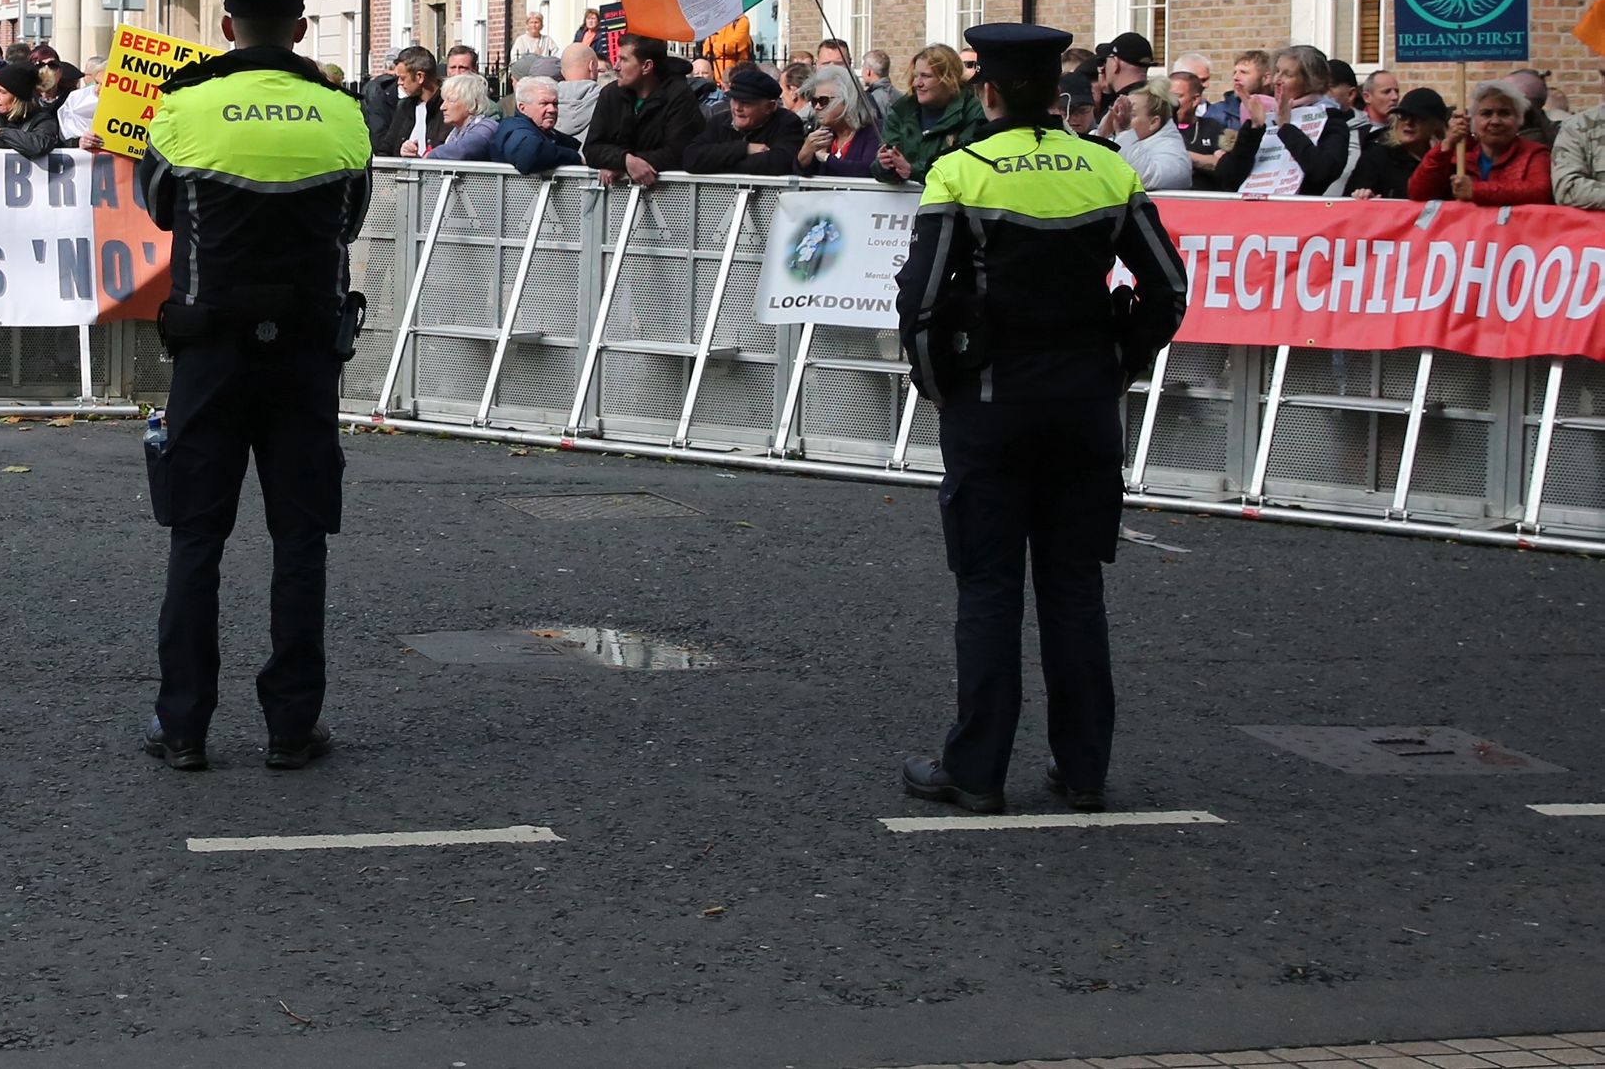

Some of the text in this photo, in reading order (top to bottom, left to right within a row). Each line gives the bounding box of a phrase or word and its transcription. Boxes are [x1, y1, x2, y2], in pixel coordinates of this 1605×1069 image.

[119, 31, 171, 57] BEEP
[173, 46, 193, 62] IF
[1398, 31, 1526, 47] IRELAND FIRST
[105, 72, 161, 101] POLIT
[222, 104, 323, 122] GARDA
[993, 153, 1093, 174] GARDA
[867, 237, 898, 247] Loved
[32, 237, 156, 301] 'NO'
[865, 272, 891, 280] Mental
[768, 294, 893, 312] LOCKDOWN
